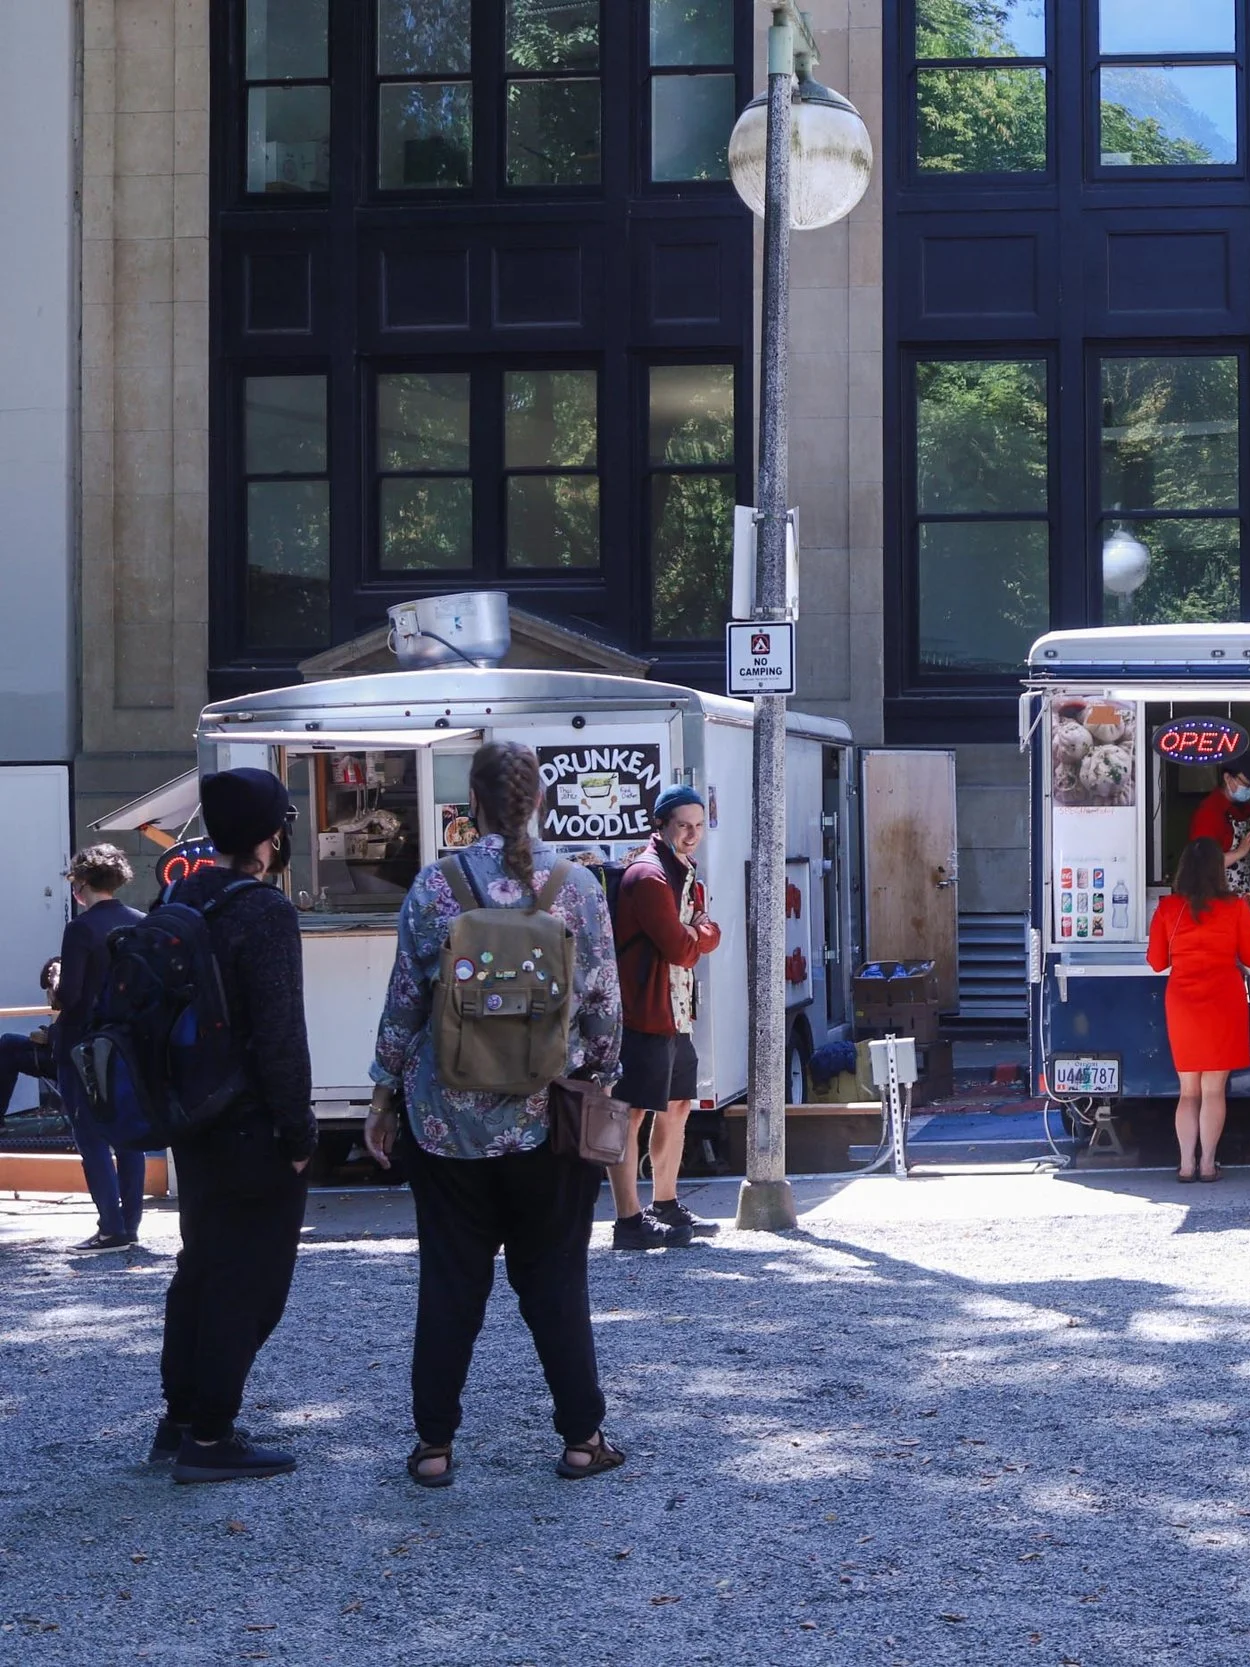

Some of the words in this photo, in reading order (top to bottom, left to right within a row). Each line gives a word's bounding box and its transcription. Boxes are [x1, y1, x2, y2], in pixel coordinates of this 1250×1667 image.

[739, 667, 783, 676] CAMPING
[754, 657, 768, 666] NO
[1160, 731, 1240, 753] OPEN
[539, 747, 661, 791] DRUNKEN
[544, 808, 652, 837] NOODLE
